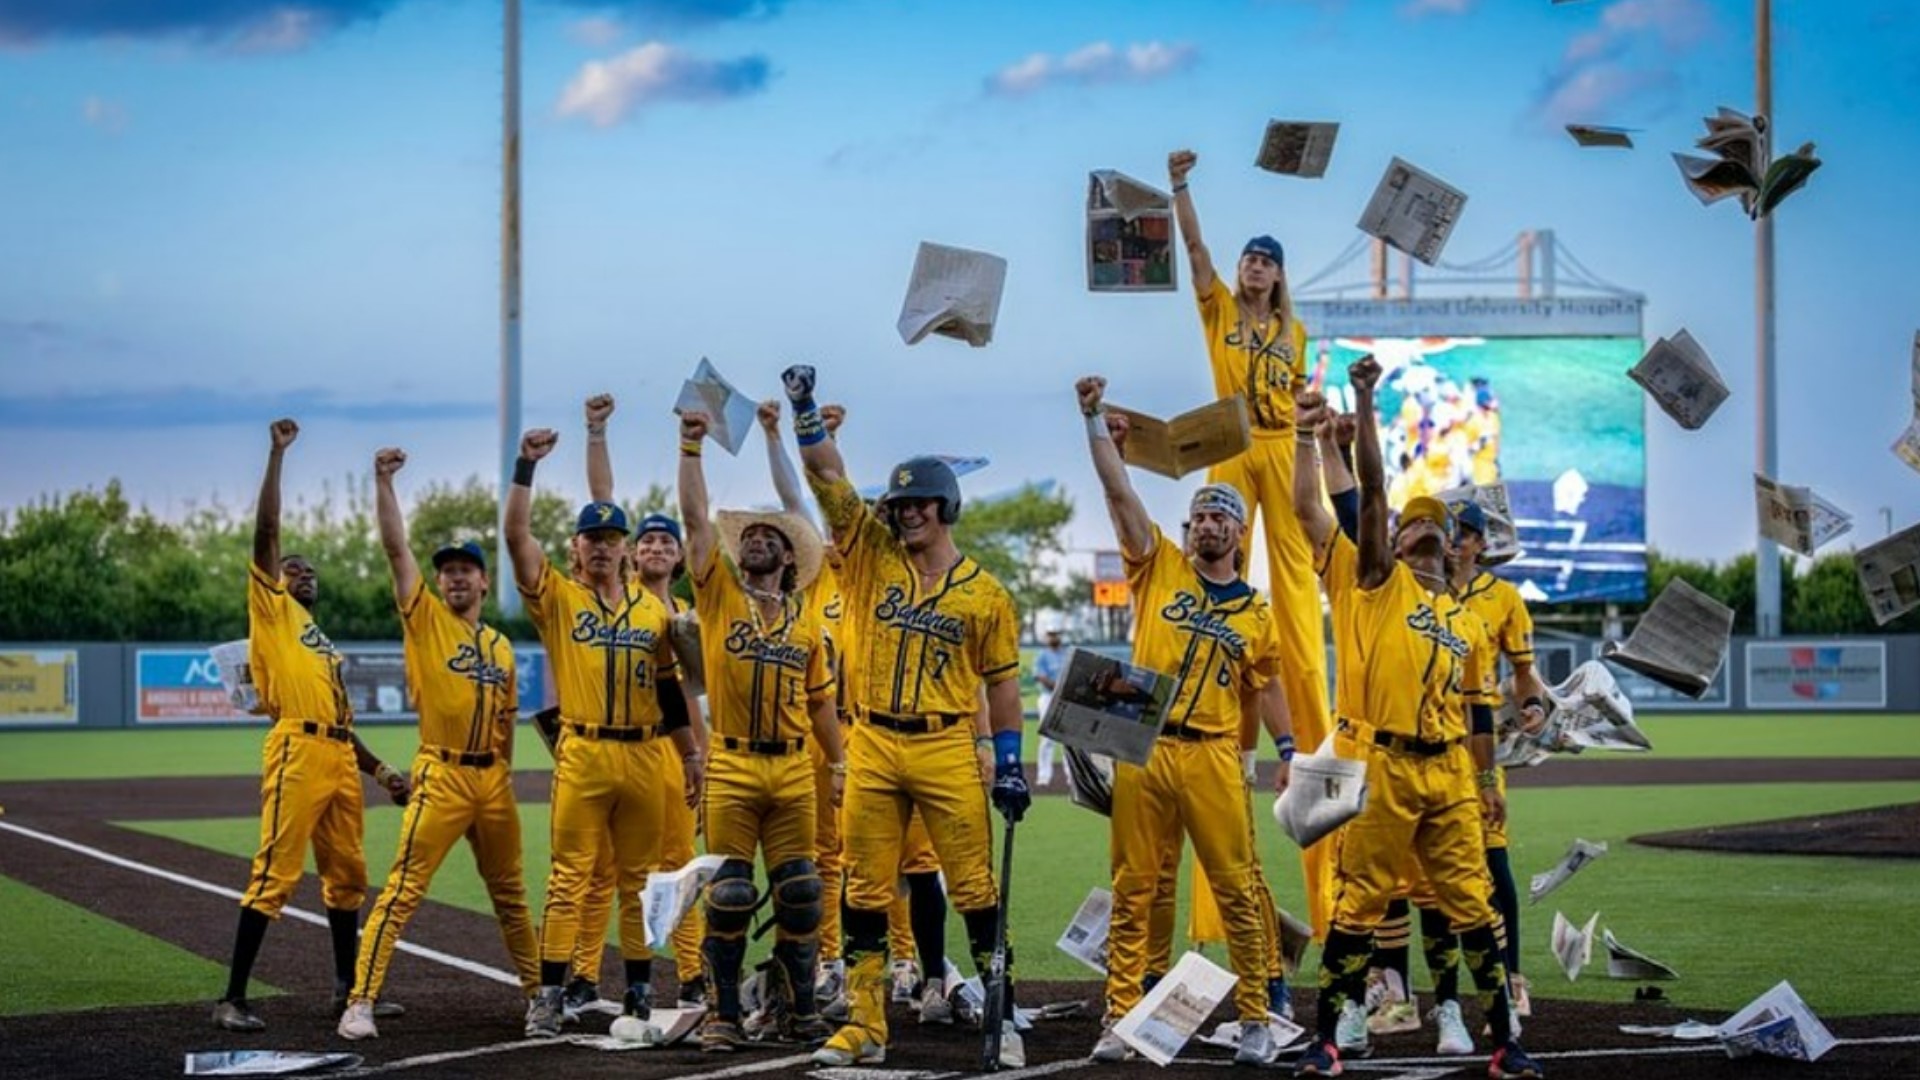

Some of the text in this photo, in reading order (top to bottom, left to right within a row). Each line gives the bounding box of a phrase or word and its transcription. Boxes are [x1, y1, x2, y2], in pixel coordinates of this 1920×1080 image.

[1323, 300, 1642, 319] Staten Island University Hospital
[934, 648, 950, 678] 7
